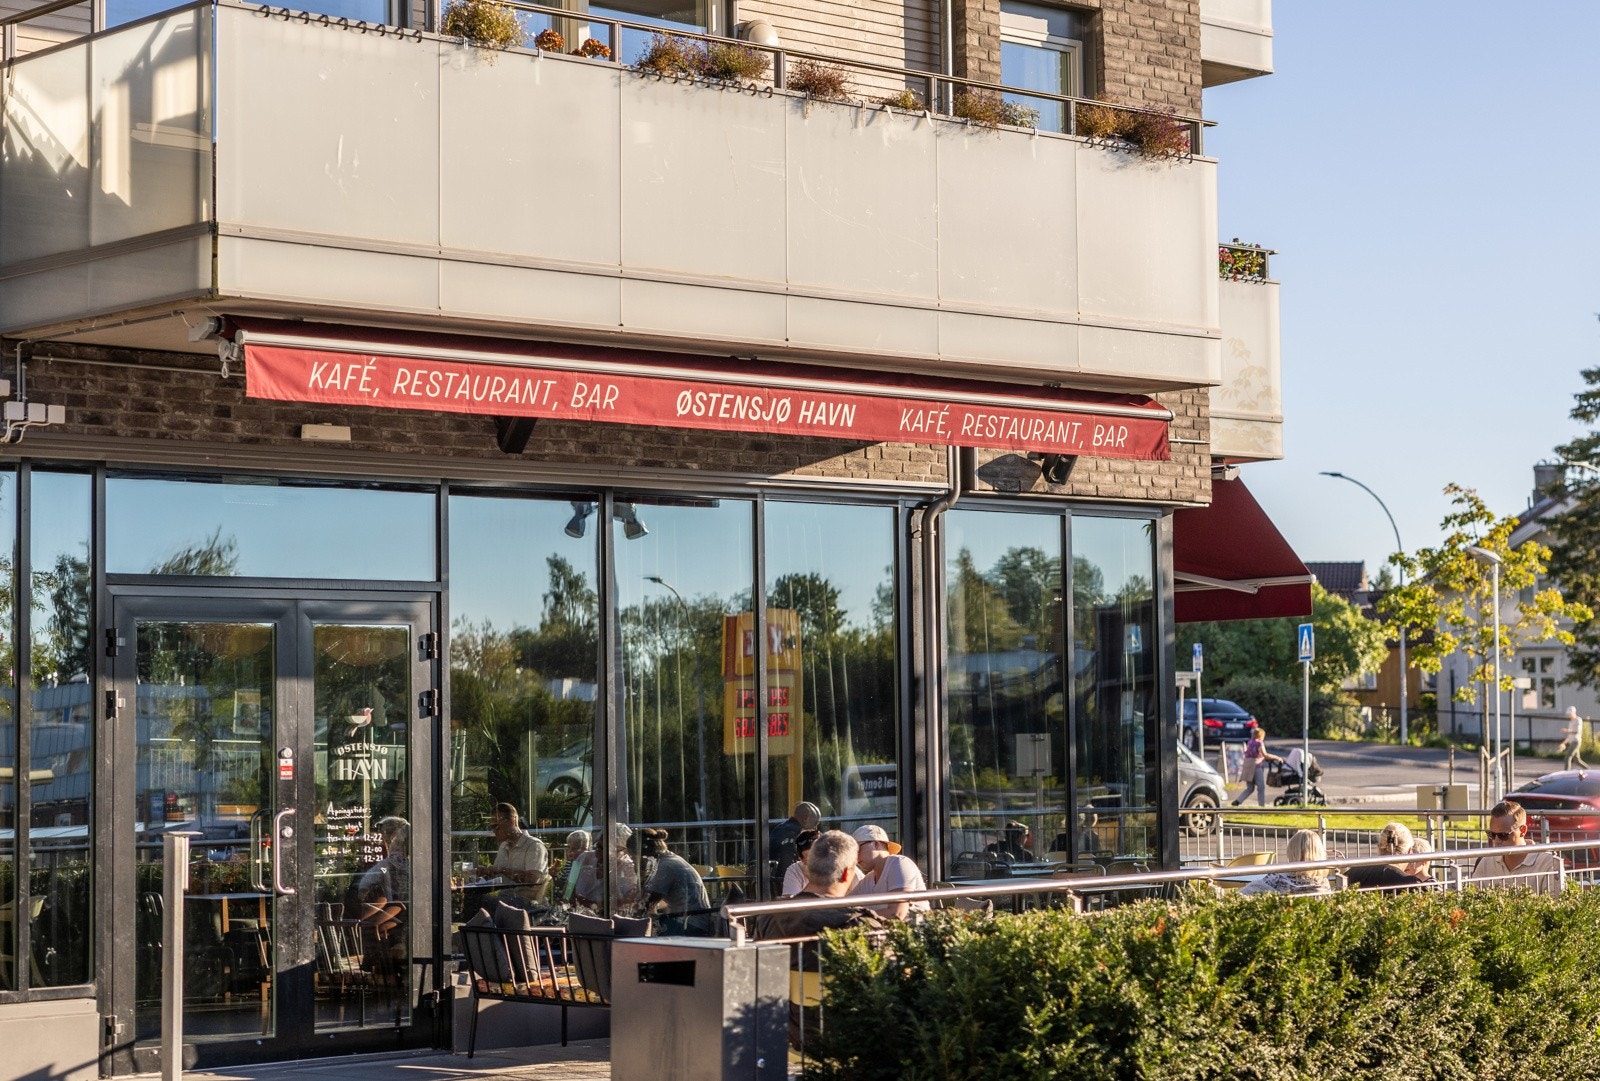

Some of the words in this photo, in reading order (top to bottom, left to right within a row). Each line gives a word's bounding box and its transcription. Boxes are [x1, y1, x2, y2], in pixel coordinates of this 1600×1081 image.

[308, 356, 380, 399] KAFÉ,
[392, 366, 558, 412] RESTAURANT,
[570, 380, 620, 410] BAR
[676, 390, 792, 424] ØSTENSJØ
[797, 399, 857, 428] HAVN
[899, 403, 952, 440] KAFÉ,
[960, 412, 1085, 448] RESTAURANT,
[1092, 424, 1129, 448] BAR
[337, 742, 389, 756] ØSTENSJØ
[339, 758, 387, 781] HAVN
